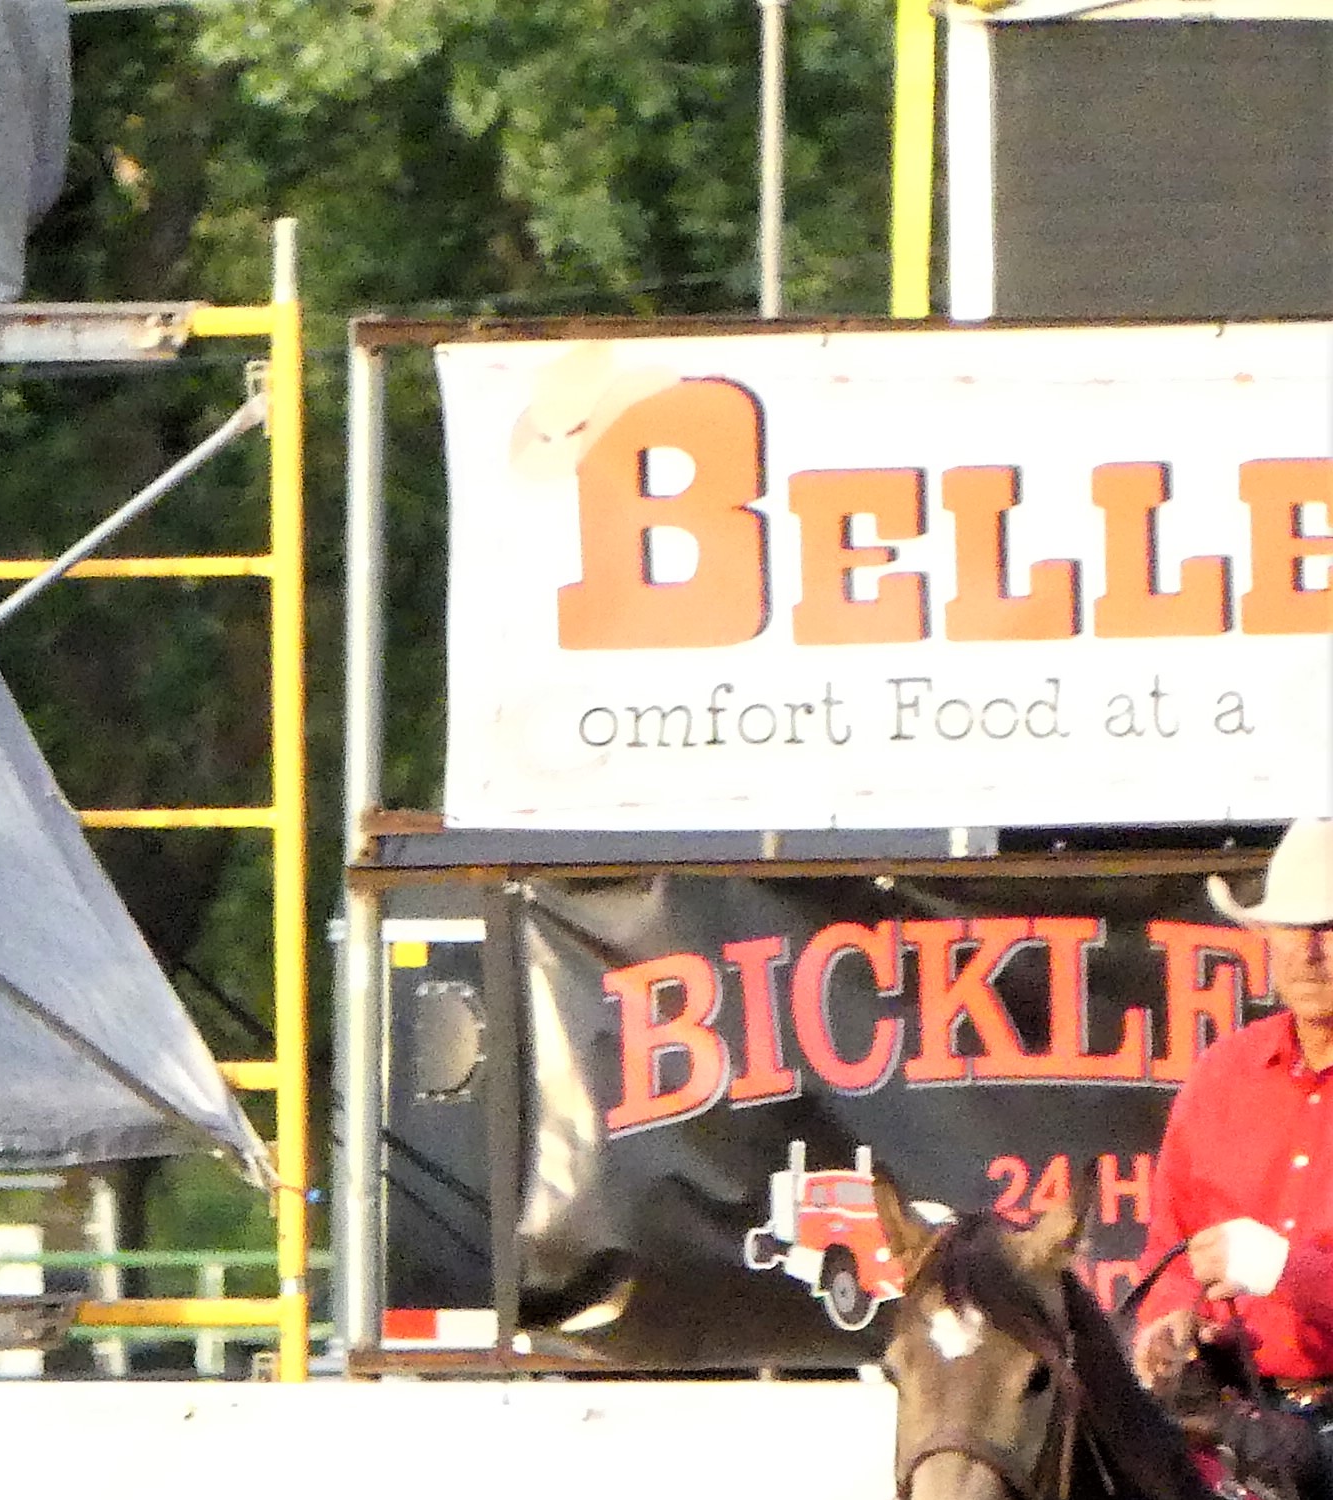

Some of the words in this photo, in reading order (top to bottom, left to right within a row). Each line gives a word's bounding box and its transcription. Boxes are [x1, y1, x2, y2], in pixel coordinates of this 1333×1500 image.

[578, 680, 852, 748] omfort
[888, 677, 1070, 741] Food
[1104, 675, 1179, 738] at
[1213, 690, 1255, 736] a
[986, 1153, 1071, 1224] 24
[1098, 1153, 1153, 1224] H
